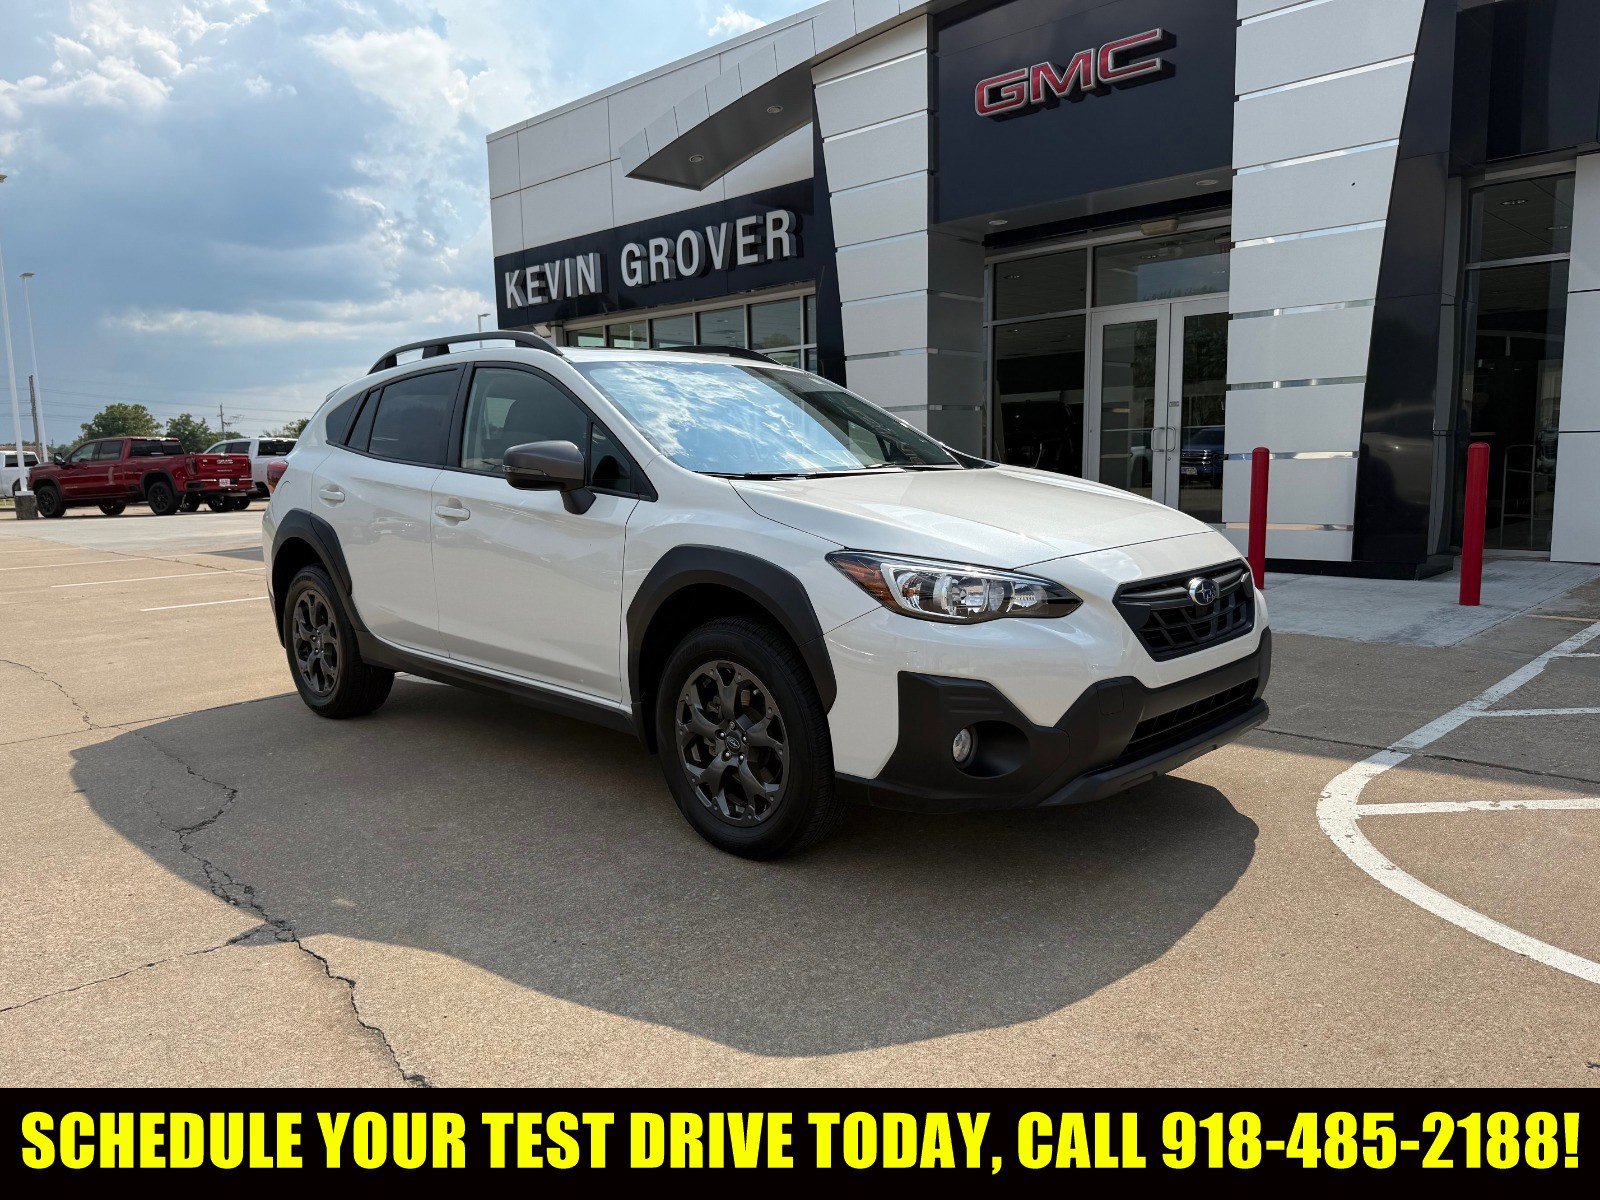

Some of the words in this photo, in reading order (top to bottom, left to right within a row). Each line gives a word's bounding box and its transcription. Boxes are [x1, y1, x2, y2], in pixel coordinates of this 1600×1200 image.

[975, 28, 1162, 116] GMC
[505, 253, 602, 308] KEVIN
[621, 209, 797, 287] GROVER
